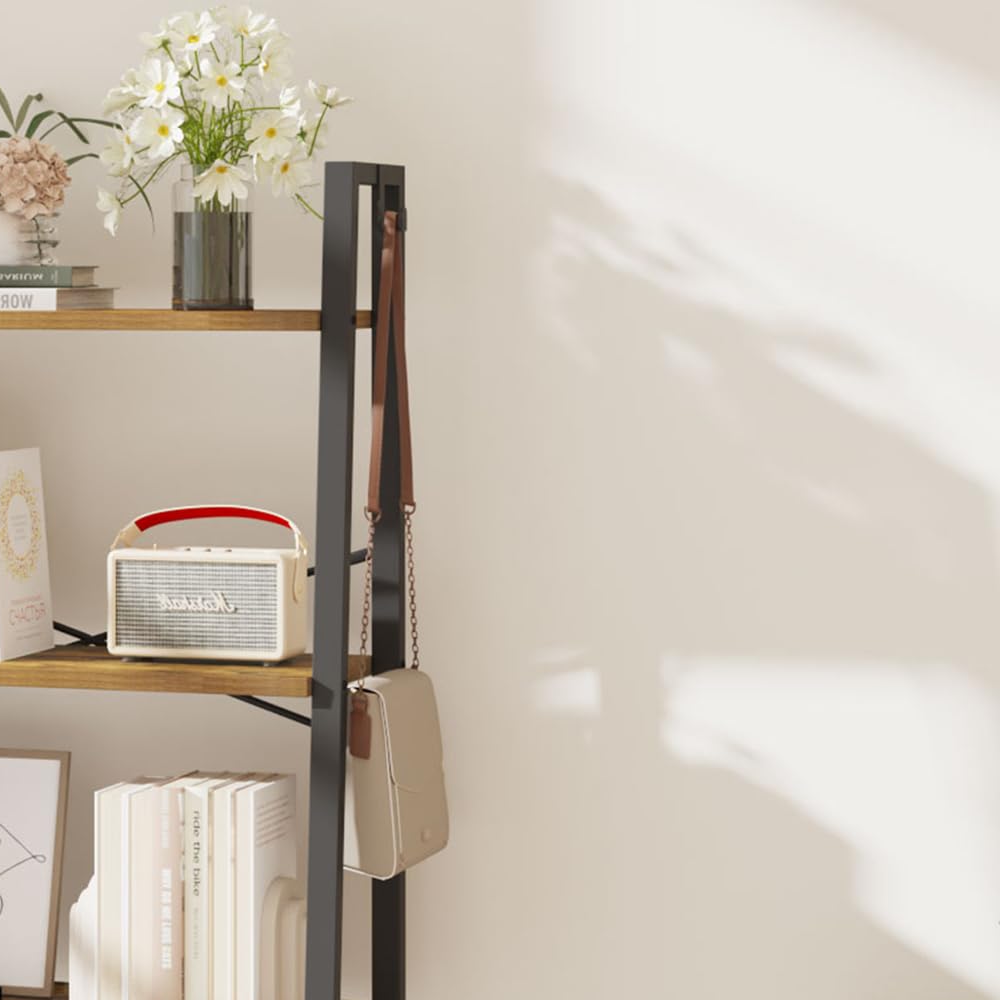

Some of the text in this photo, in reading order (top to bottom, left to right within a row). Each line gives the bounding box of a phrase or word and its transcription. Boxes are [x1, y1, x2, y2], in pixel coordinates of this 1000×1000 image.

[193, 810, 201, 897] ride the bike
